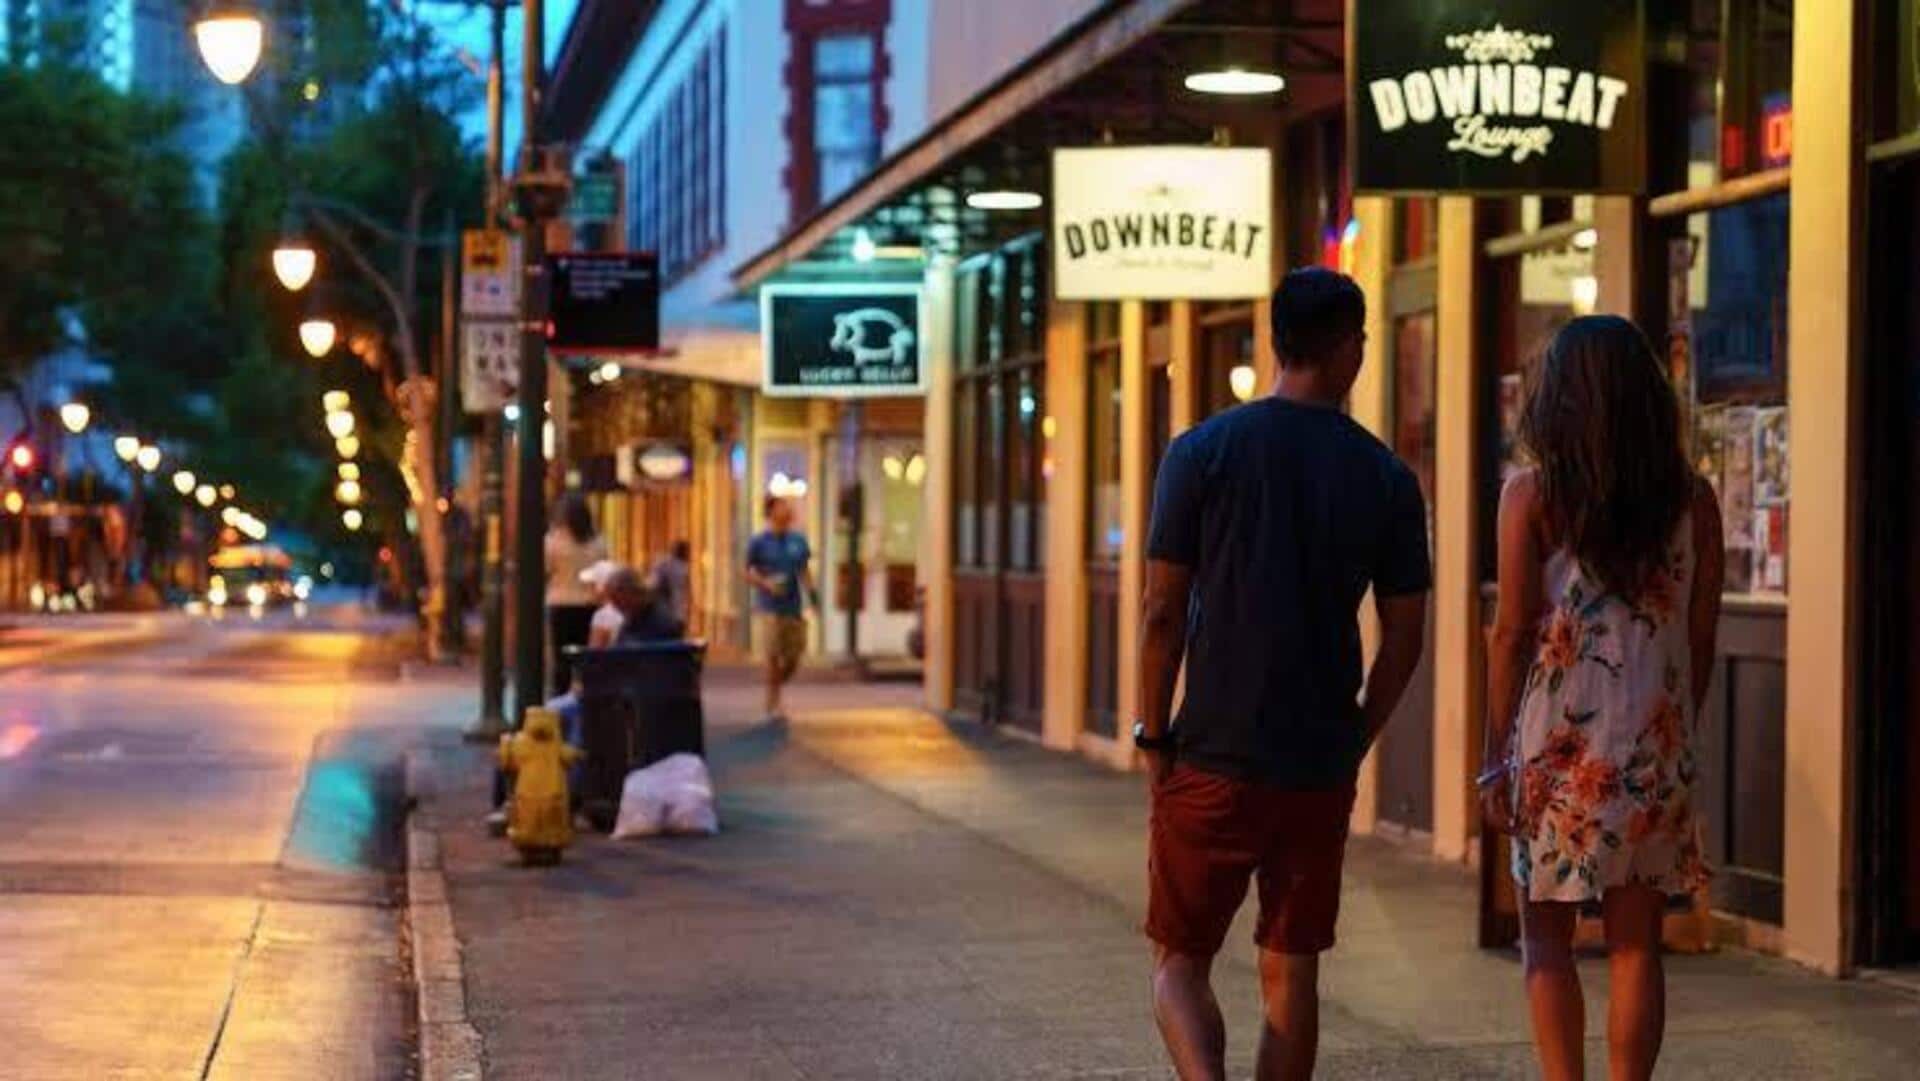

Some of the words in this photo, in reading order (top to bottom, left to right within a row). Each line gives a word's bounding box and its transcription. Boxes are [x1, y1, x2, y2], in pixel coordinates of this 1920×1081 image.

[1369, 63, 1628, 132] DOWNBEAT
[1447, 114, 1553, 163] Lounge
[1063, 213, 1263, 260] DOWNBEAT
